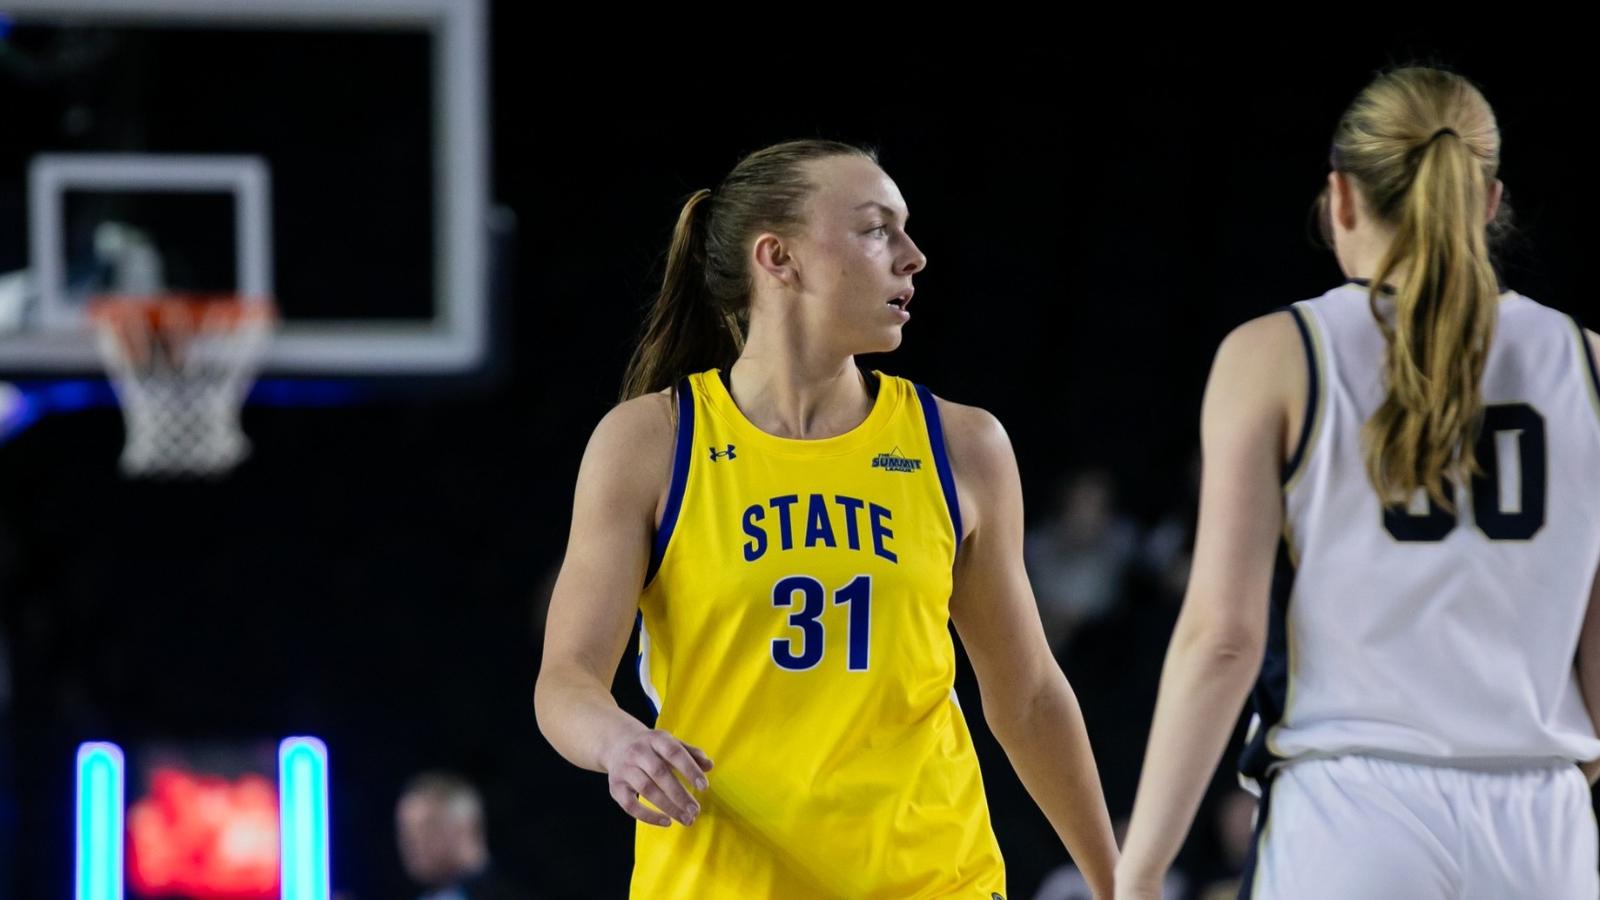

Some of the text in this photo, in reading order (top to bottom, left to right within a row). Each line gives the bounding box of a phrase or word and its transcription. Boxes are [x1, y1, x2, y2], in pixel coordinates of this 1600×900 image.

[871, 457, 922, 470] SUMMIT
[742, 493, 899, 564] STATE
[771, 574, 872, 673] 31
